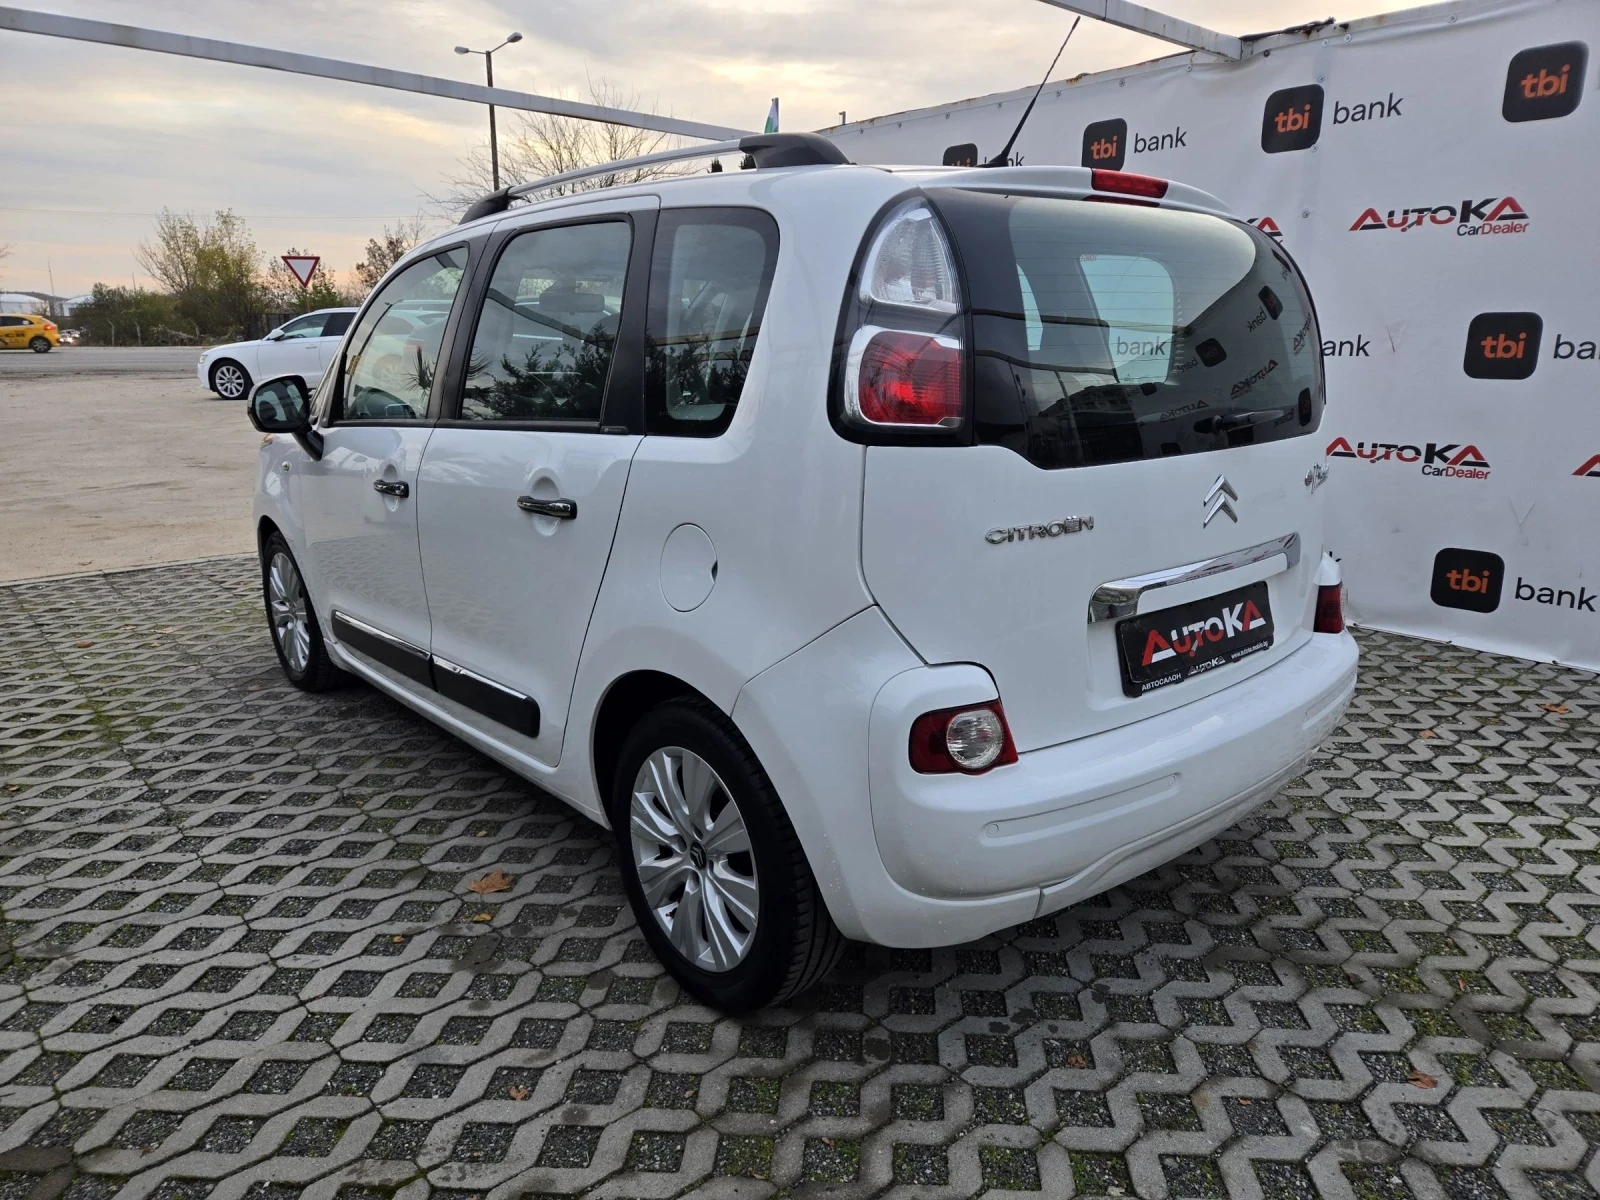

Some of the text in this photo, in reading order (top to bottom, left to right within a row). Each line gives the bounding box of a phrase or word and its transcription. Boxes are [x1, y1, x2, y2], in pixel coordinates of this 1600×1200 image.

[1521, 64, 1570, 98] tbi
[1275, 93, 1404, 133] tbi bank
[1091, 126, 1187, 160] tbi bank
[1456, 222, 1529, 236] CarDealer
[1117, 336, 1166, 356] bank
[1321, 334, 1371, 357] ank
[1481, 332, 1600, 360] tbi ba
[1421, 464, 1490, 480] CarDealer
[984, 515, 1094, 545] CITROËN
[1446, 569, 1598, 613] tbi bank
[1141, 672, 1182, 692] АВТОСАЛОН
